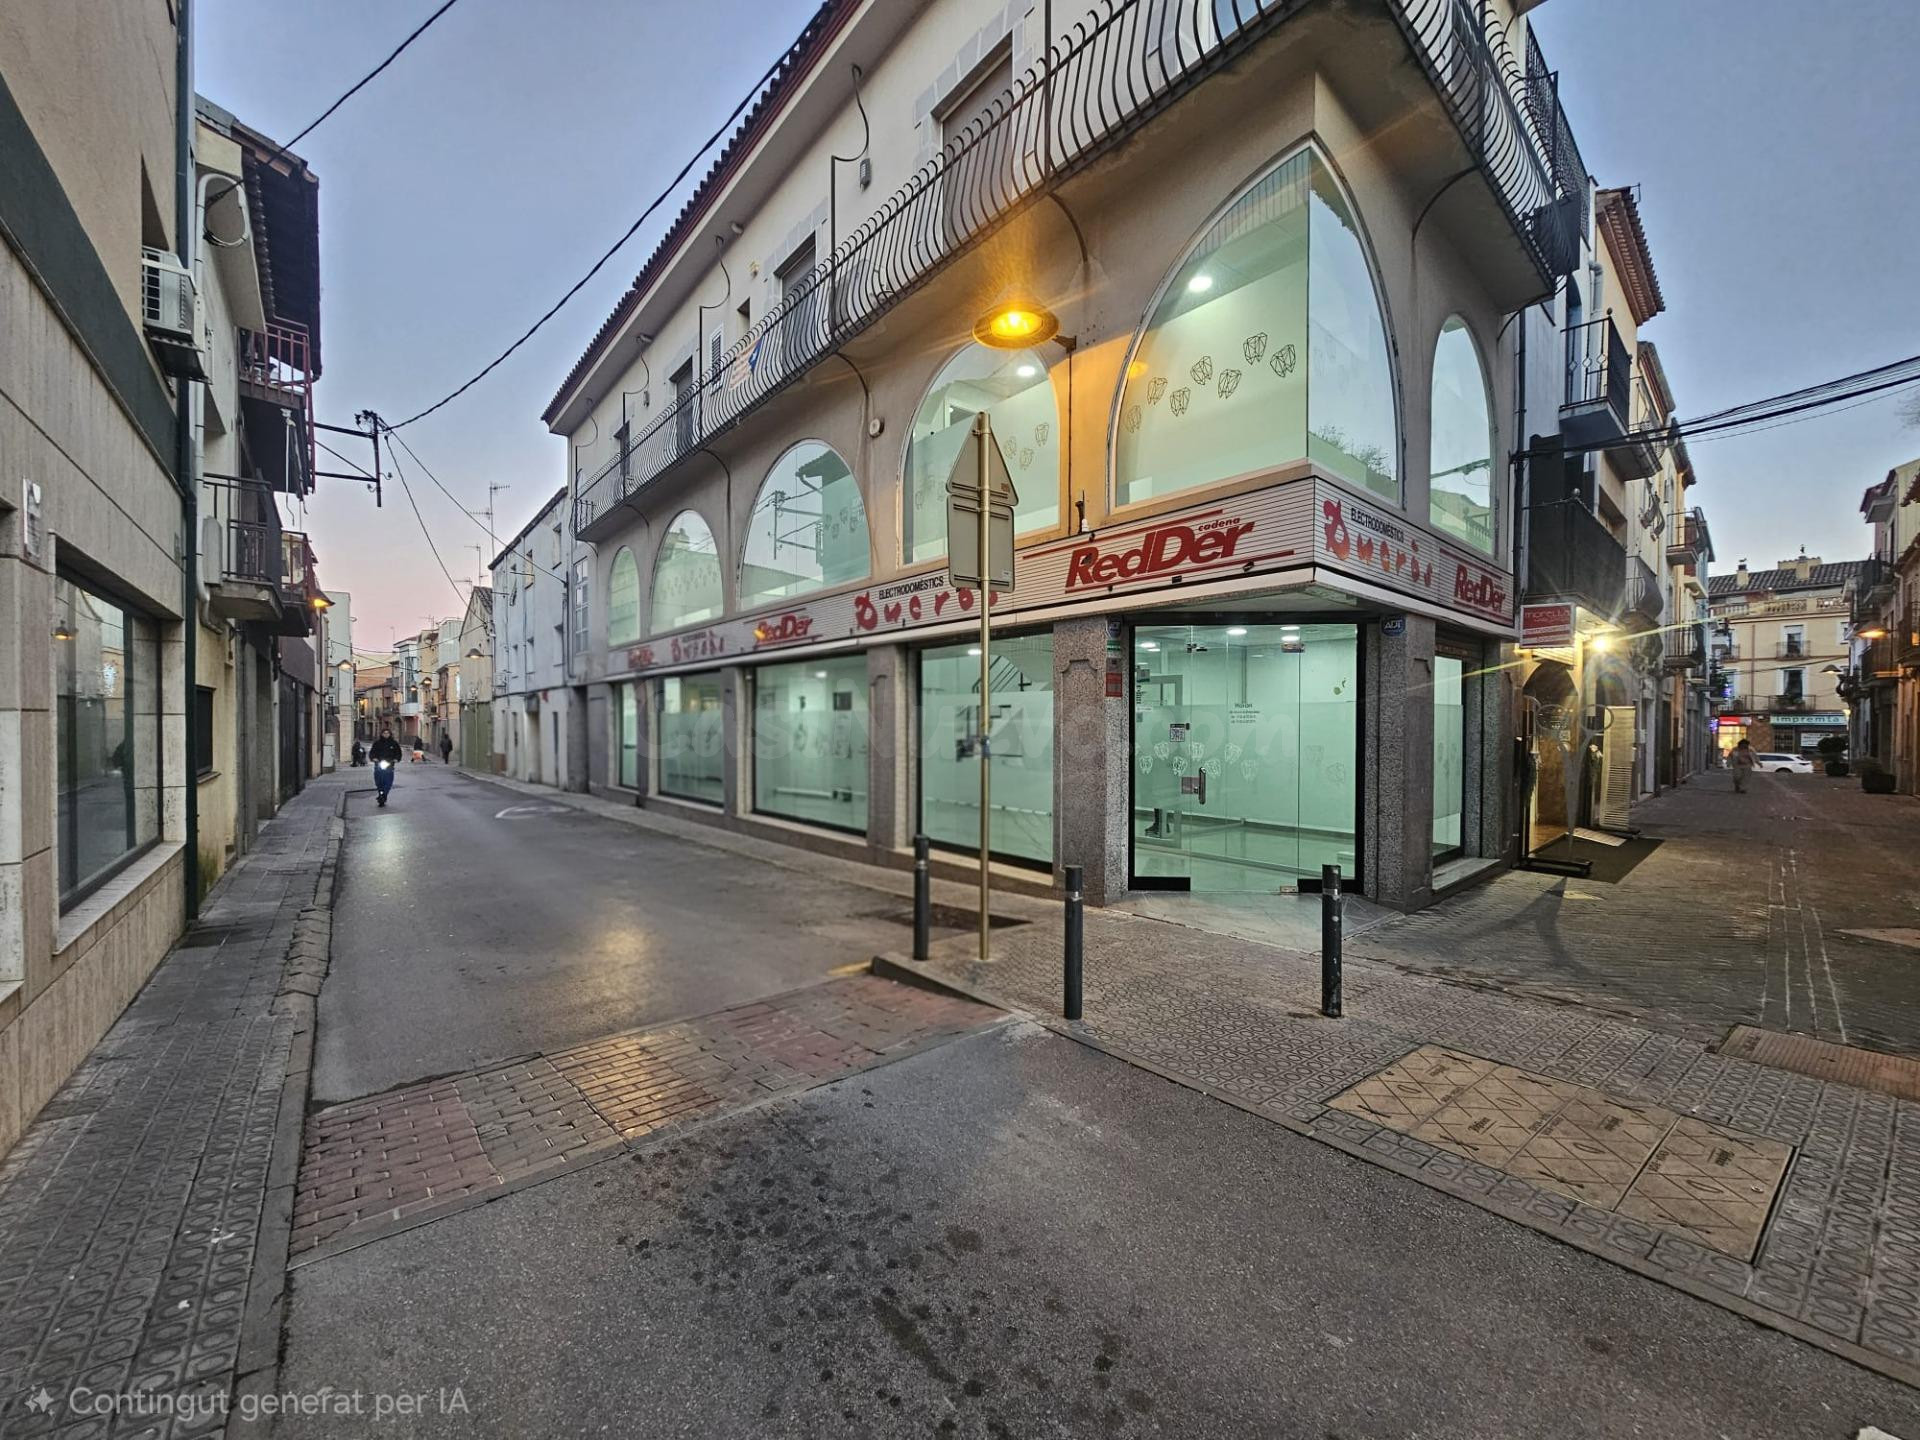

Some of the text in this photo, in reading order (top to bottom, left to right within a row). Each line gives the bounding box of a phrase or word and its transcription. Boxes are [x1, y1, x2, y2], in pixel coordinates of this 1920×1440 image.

[1198, 517, 1241, 532] cadena
[1065, 521, 1255, 588] RedDer
[879, 575, 944, 600] ELECTRODOMÈSTICS
[1455, 564, 1506, 612] RedDer
